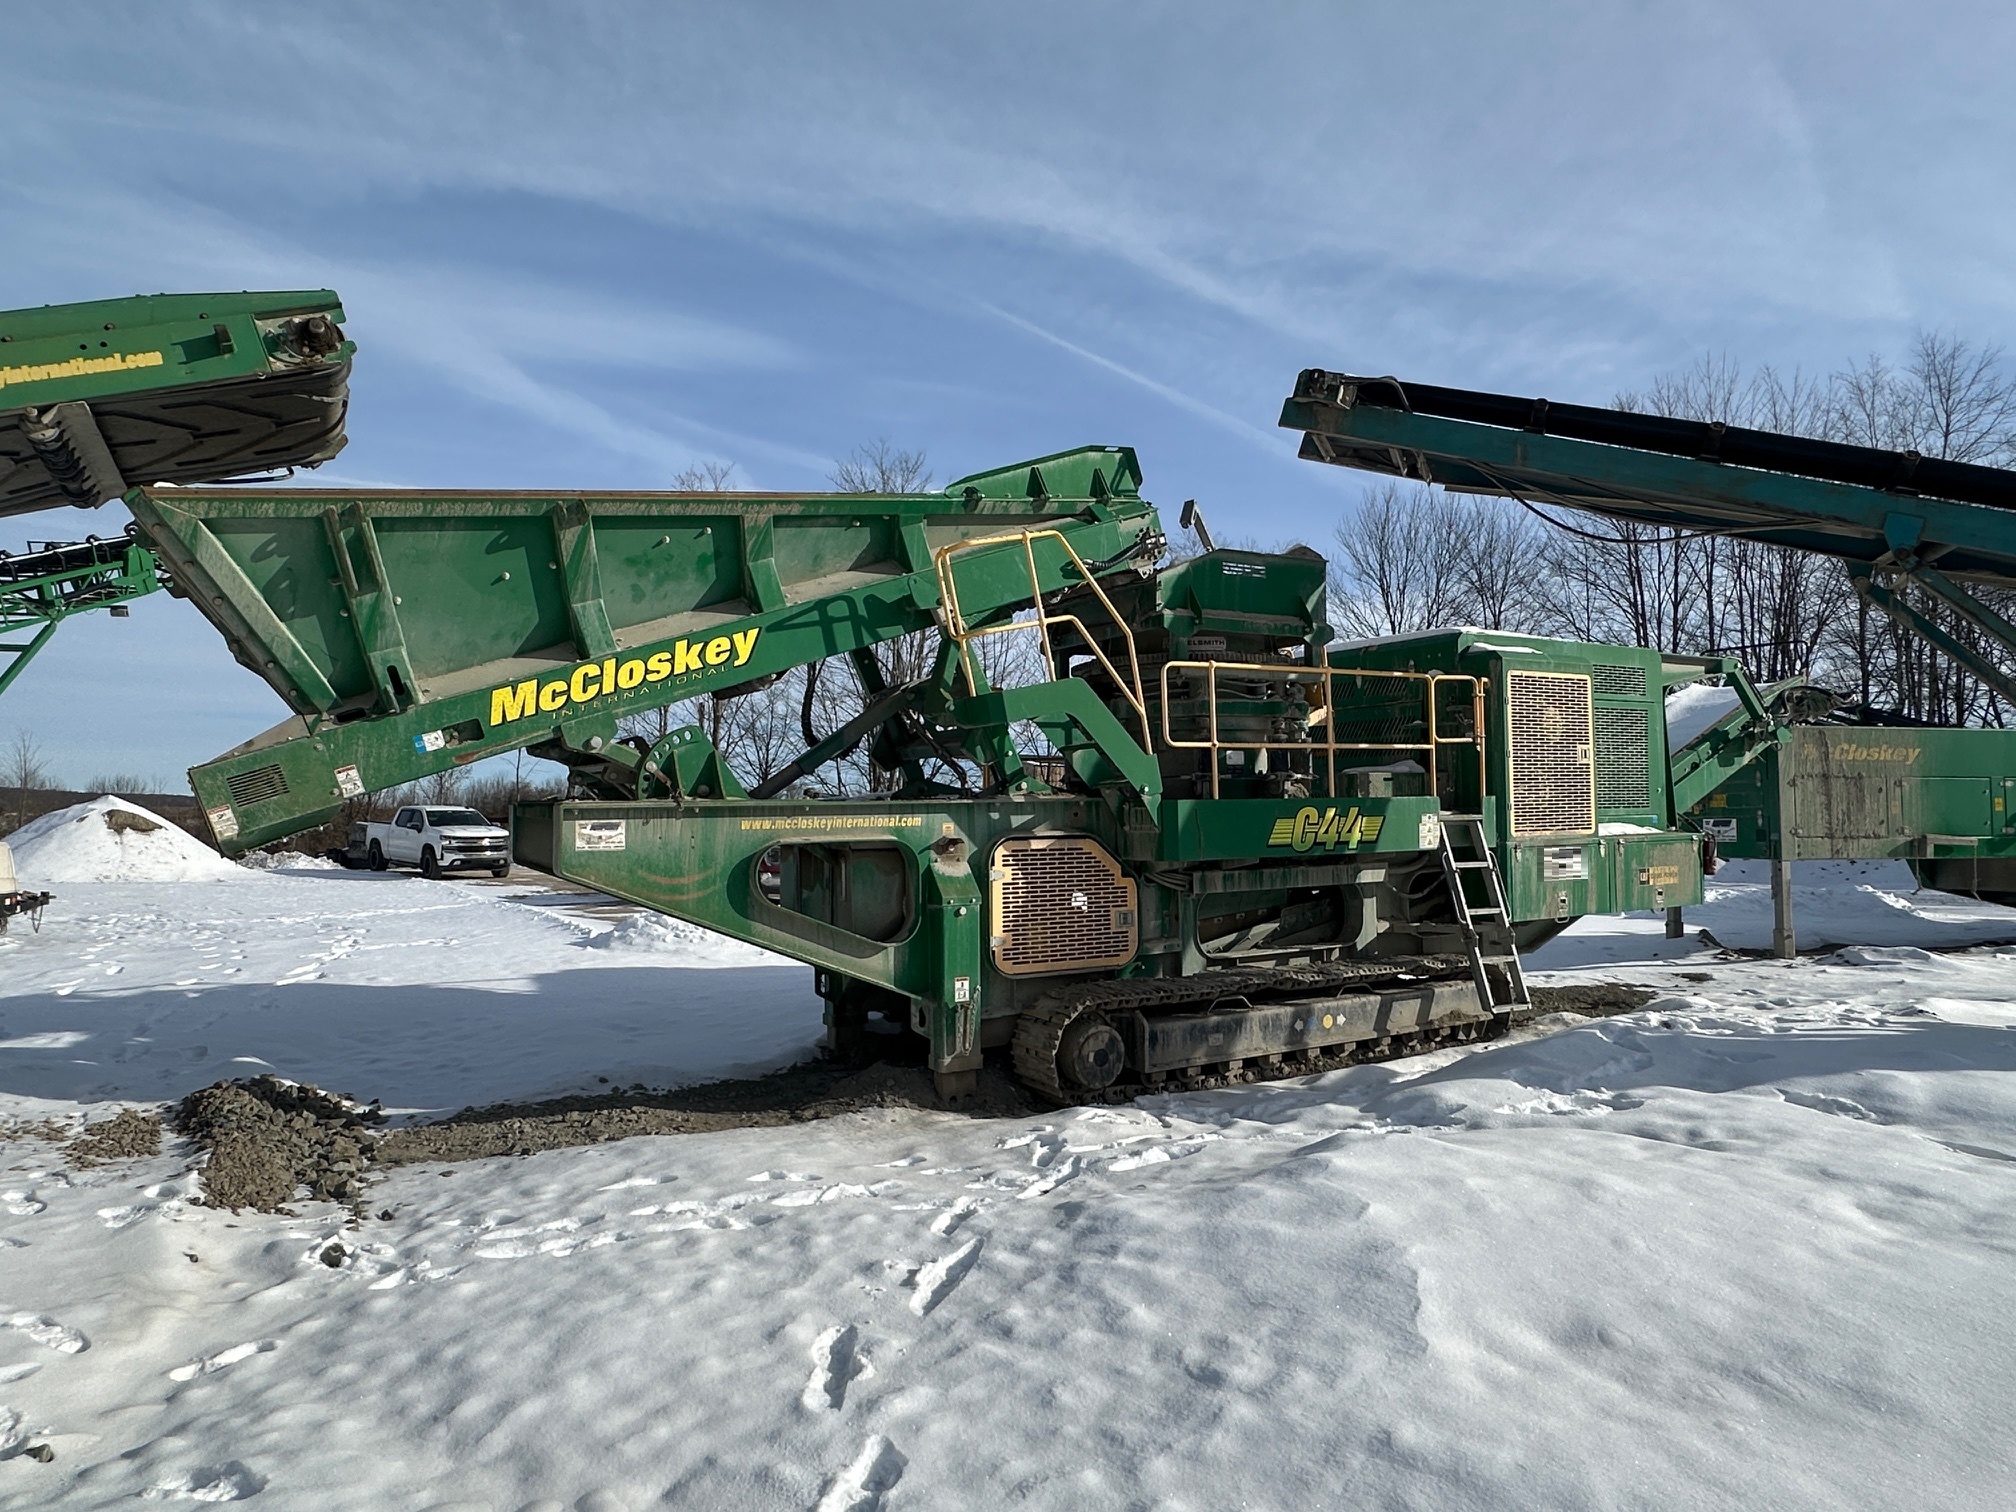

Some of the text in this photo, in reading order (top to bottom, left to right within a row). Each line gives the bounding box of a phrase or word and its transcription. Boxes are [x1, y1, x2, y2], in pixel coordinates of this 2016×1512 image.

[490, 627, 761, 727] McCloskey
[552, 664, 729, 720] INTERNATIONAL
[741, 816, 922, 831] www.mccloskeyinternational.com
